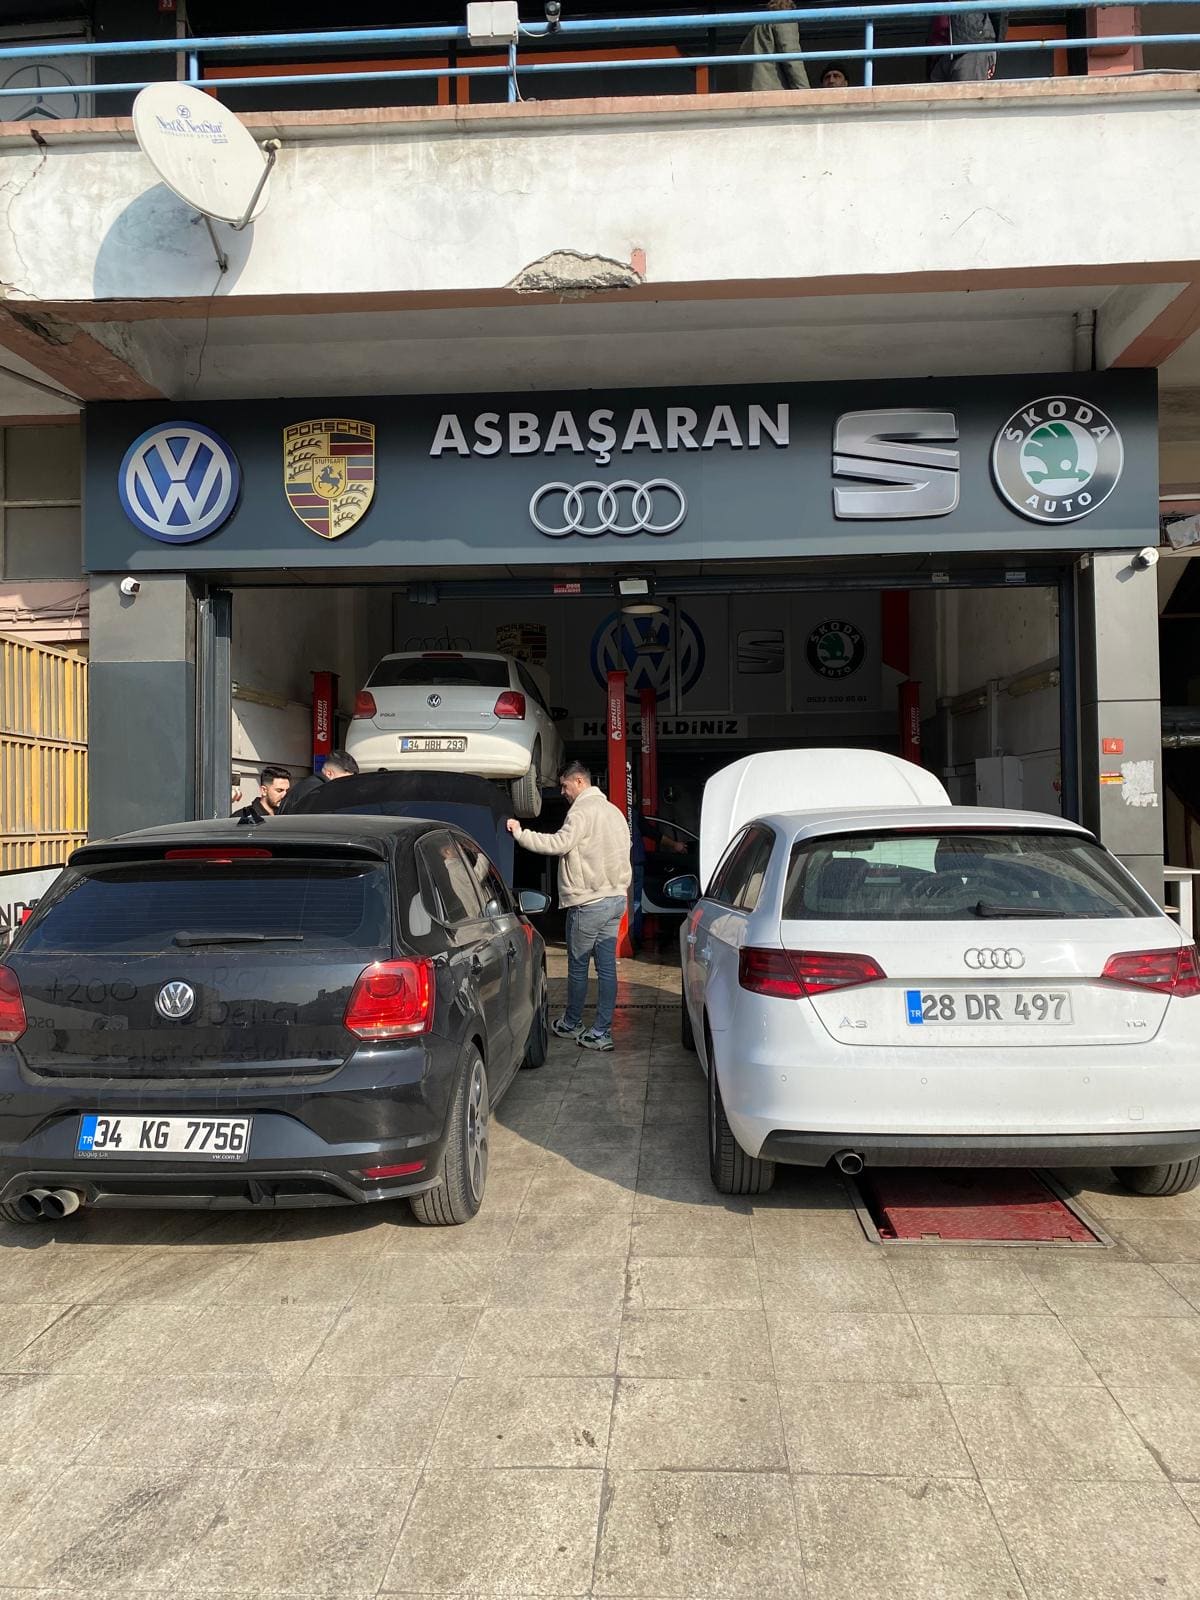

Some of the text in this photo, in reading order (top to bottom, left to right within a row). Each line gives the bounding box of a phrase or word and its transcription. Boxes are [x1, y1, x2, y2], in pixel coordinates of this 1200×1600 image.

[286, 421, 373, 441] PORSCHE
[429, 403, 790, 465] ASBAŞARAN
[1025, 492, 1092, 513] AUTO
[819, 666, 851, 677] AUTO
[408, 739, 464, 750] 34 HBH 293
[910, 994, 1067, 1021] TR 28 DR 497
[839, 1016, 868, 1029] A3
[82, 1119, 245, 1151] TR 34 KG 7756
